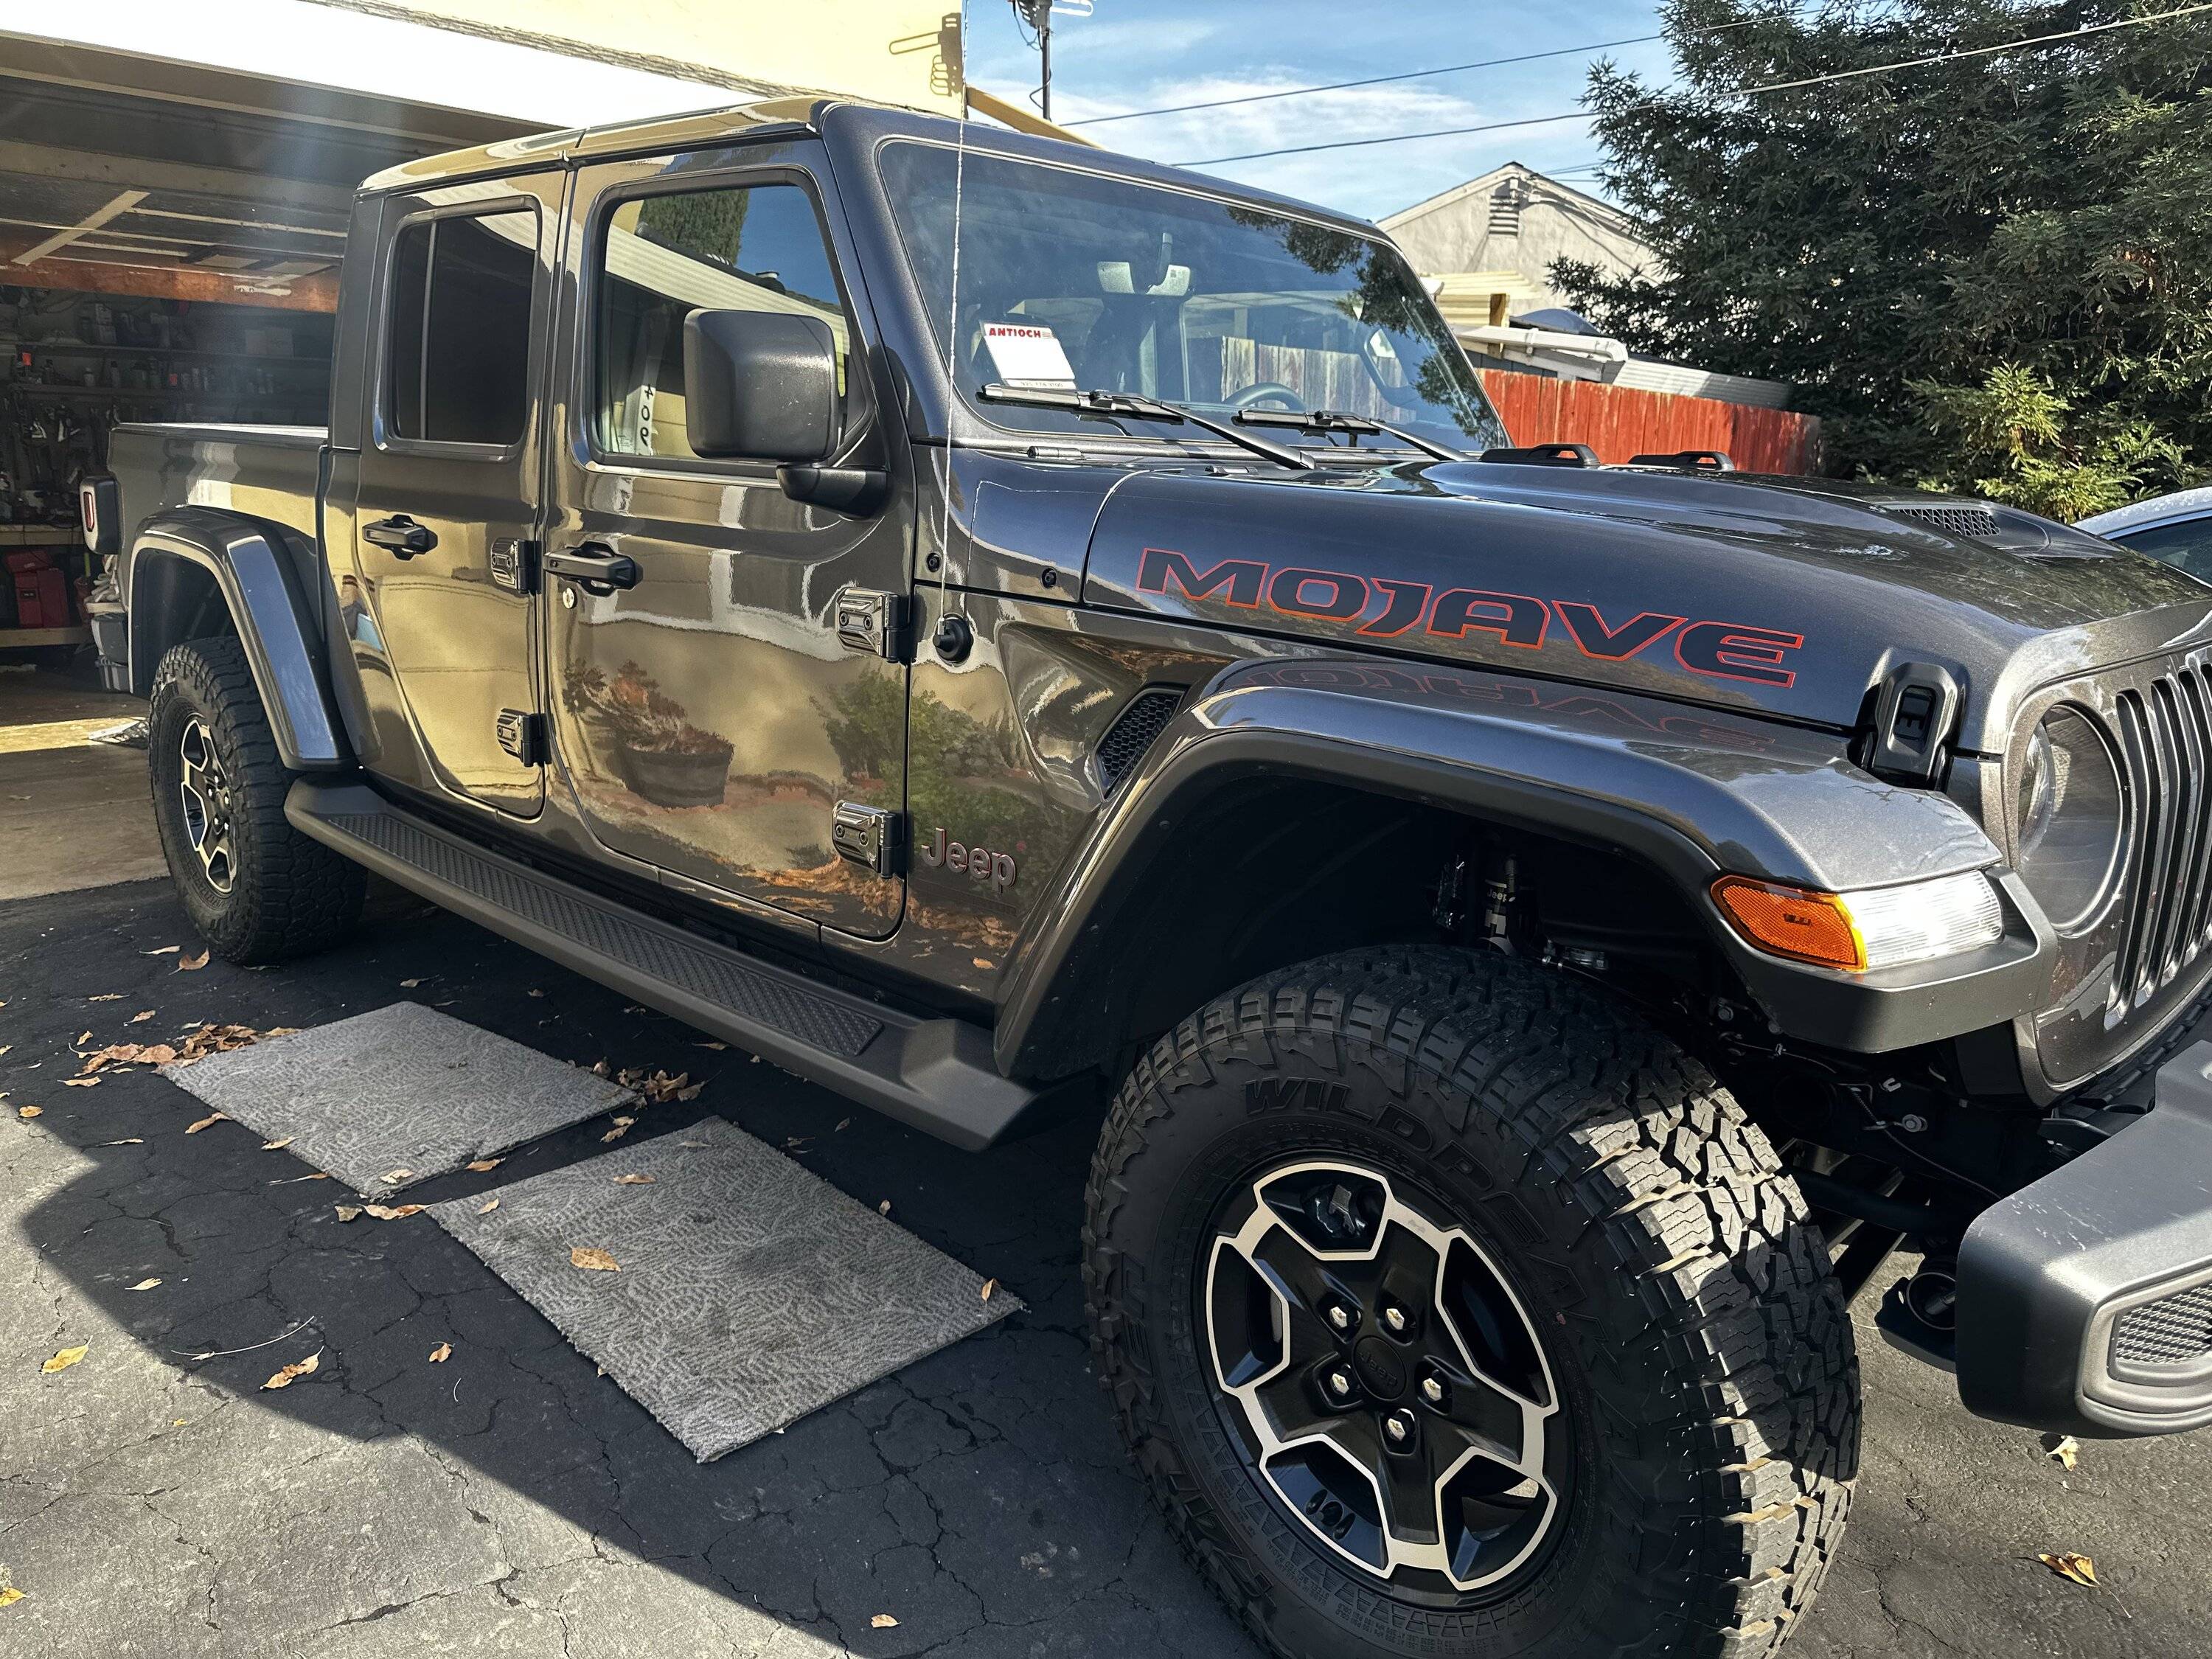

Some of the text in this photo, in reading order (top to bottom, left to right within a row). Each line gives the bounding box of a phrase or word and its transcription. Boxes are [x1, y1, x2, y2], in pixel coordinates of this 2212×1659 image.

[989, 327, 1041, 338] ANTIOCH
[1135, 548, 1804, 689] MOJAVE
[921, 827, 1017, 894] Jeep
[1245, 1077, 1624, 1384] WILDPEAK
[1358, 1352, 1398, 1389] Jeep
